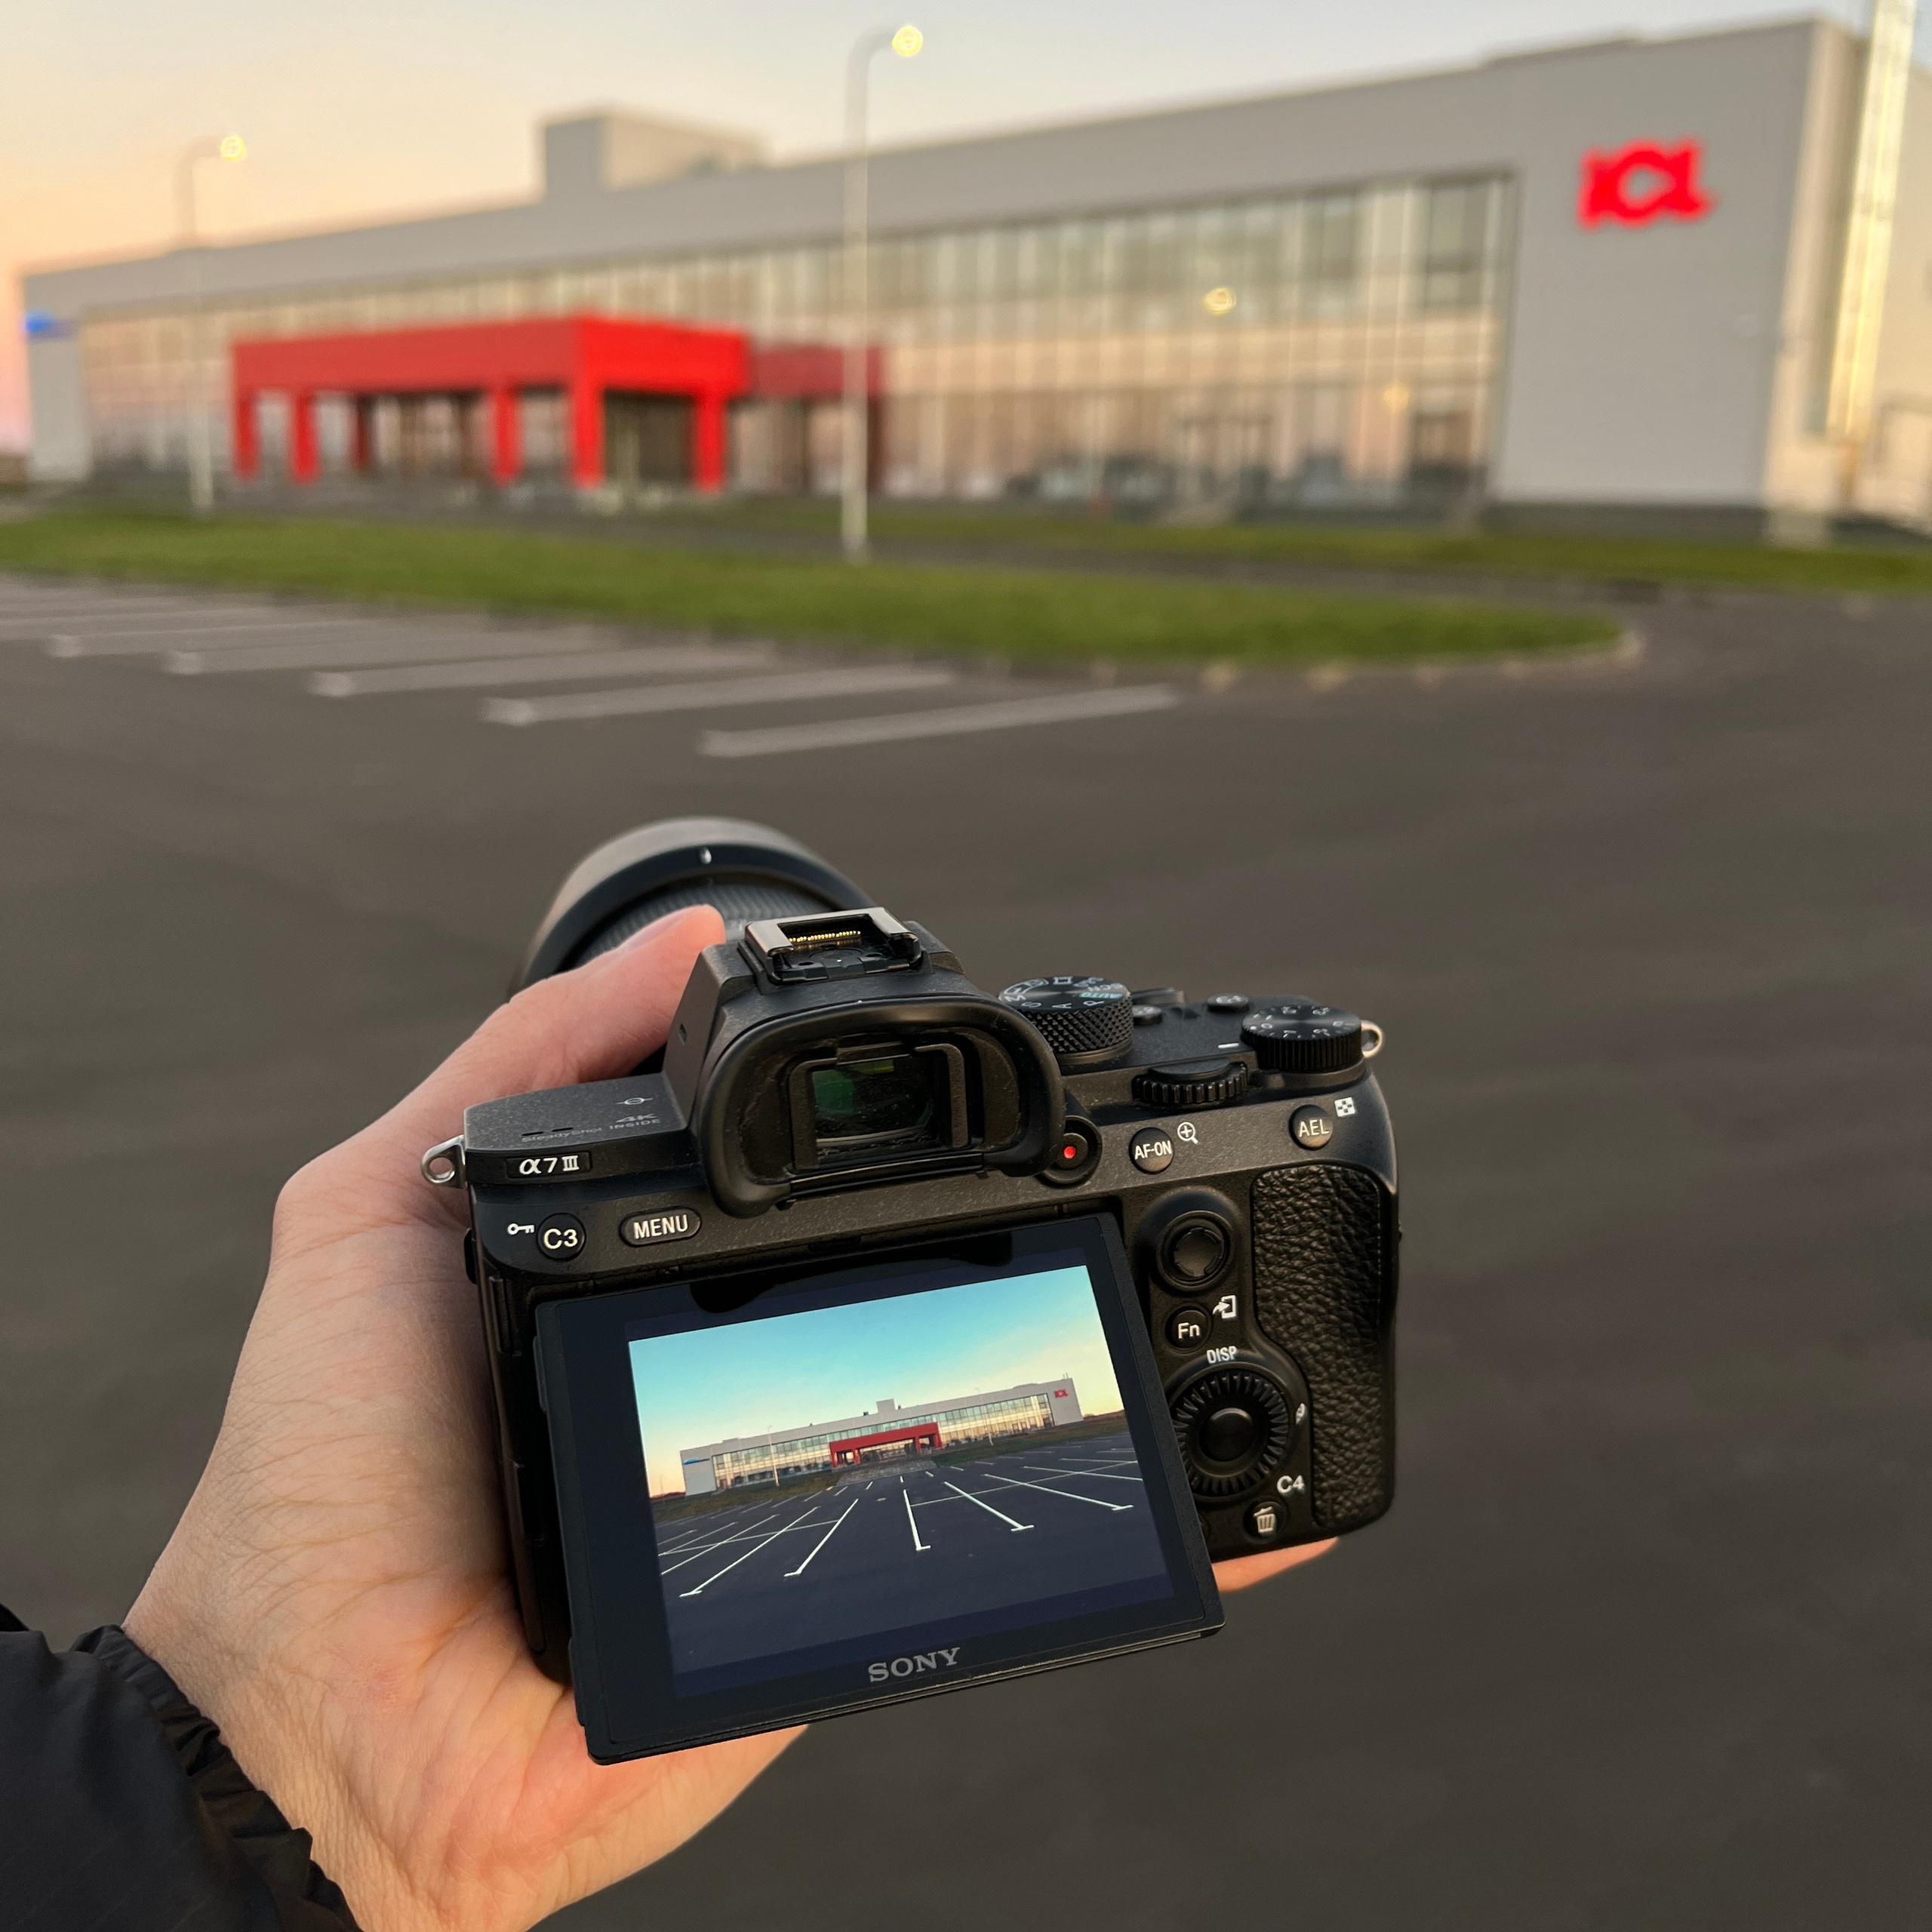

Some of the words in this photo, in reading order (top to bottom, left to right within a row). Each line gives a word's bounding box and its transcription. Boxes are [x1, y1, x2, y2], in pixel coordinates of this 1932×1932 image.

[609, 1118, 661, 1130] INSIDE
[1299, 1118, 1330, 1137] AEL
[1134, 1140, 1172, 1159] AF-ON
[633, 1214, 689, 1239] MENU
[543, 1229, 578, 1249] C3
[1177, 1322, 1200, 1339] Fn
[1207, 1346, 1238, 1364] DISP
[1277, 1475, 1304, 1494] C4
[868, 1647, 961, 1683] SONY
